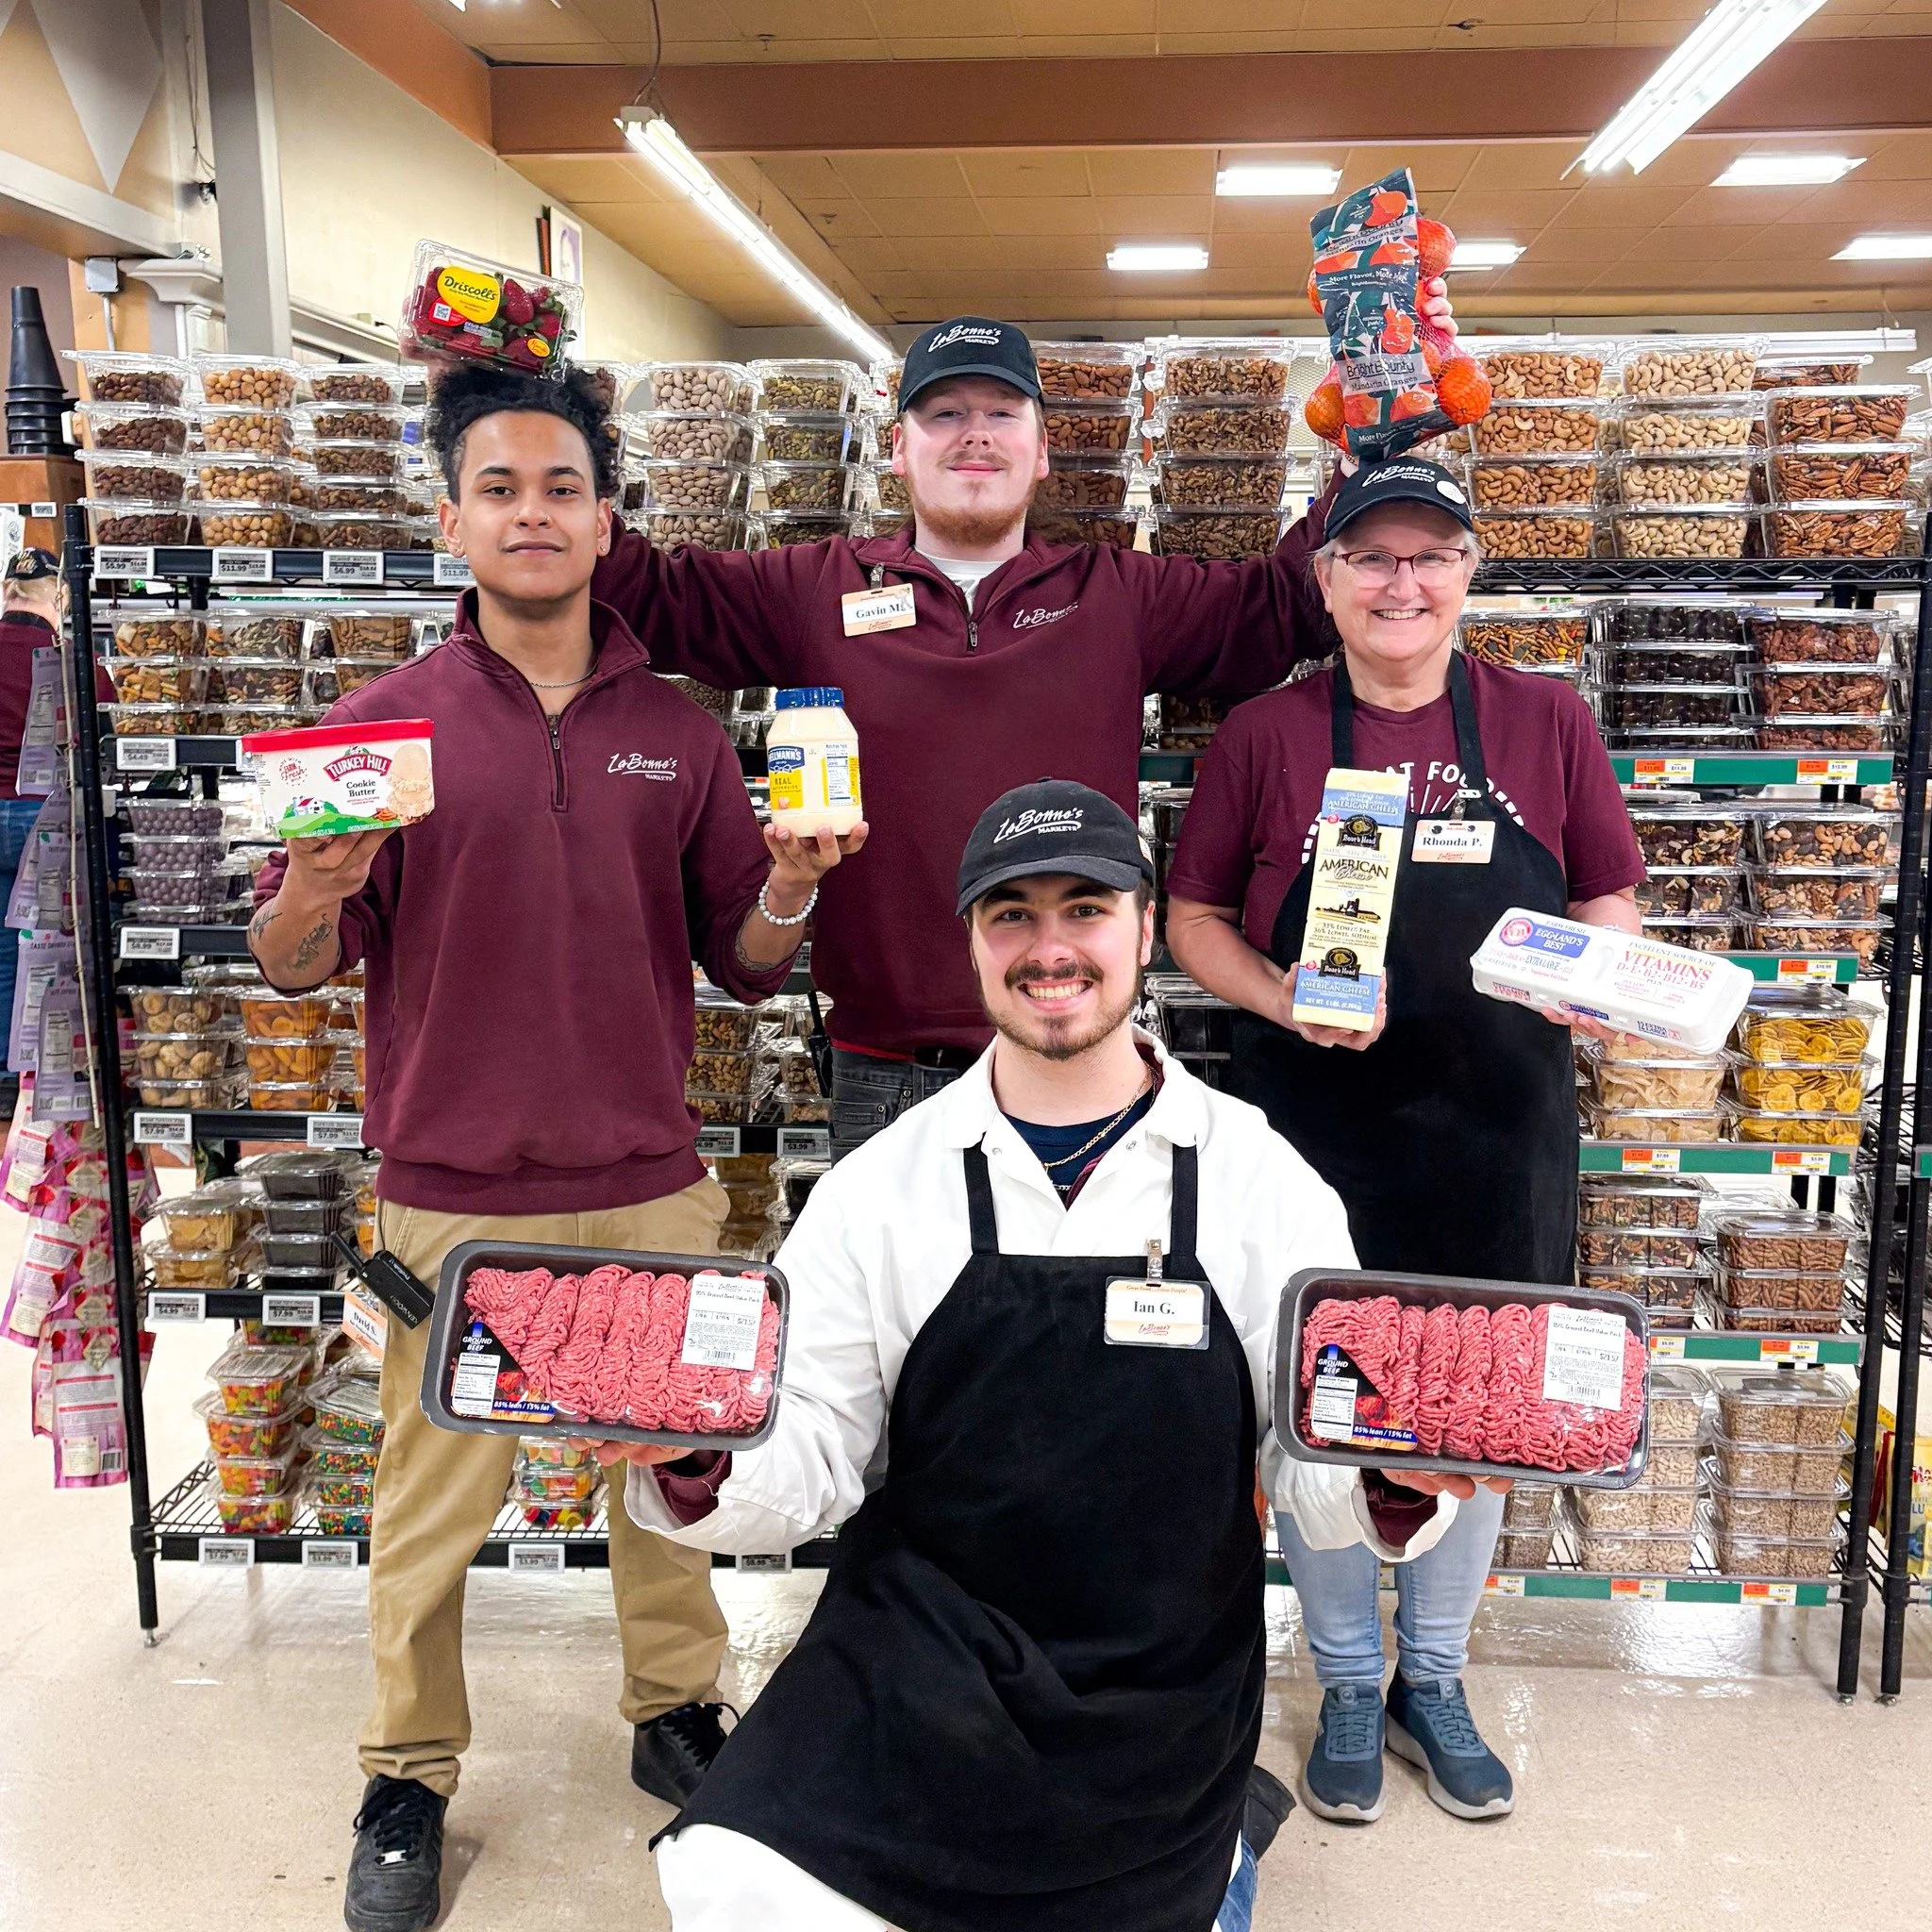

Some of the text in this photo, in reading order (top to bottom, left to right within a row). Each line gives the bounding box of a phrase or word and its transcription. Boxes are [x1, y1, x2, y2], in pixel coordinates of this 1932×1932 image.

[1328, 275, 1348, 284] More
[1349, 272, 1374, 280] Flavor,
[444, 275, 498, 301] Driscoll's
[1383, 376, 1419, 387] Oanges
[1358, 434, 1375, 443] More
[221, 564, 246, 573] $11.99
[856, 607, 887, 619] Gavin
[327, 756, 389, 777] TURKEY HILL
[608, 753, 677, 774] LaBonne's
[346, 779, 376, 789] Cookie
[774, 777, 792, 786] REAL
[348, 789, 376, 798] Butter
[1327, 800, 1369, 811] AMERICAN
[1361, 836, 1376, 845] Head
[1423, 837, 1483, 847] Rhonda P.
[1319, 858, 1390, 879] AMERICAN
[1543, 940, 1566, 952] BEST
[1673, 952, 1703, 962] SOURCE
[1624, 951, 1713, 982] VITAMINS
[1301, 980, 1372, 996] AMERICAN CHEESE
[1133, 1301, 1175, 1315] Ian G.
[462, 1336, 492, 1345] GROUND
[1318, 1358, 1348, 1368] GROUND
[1388, 1429, 1402, 1438] 15%
